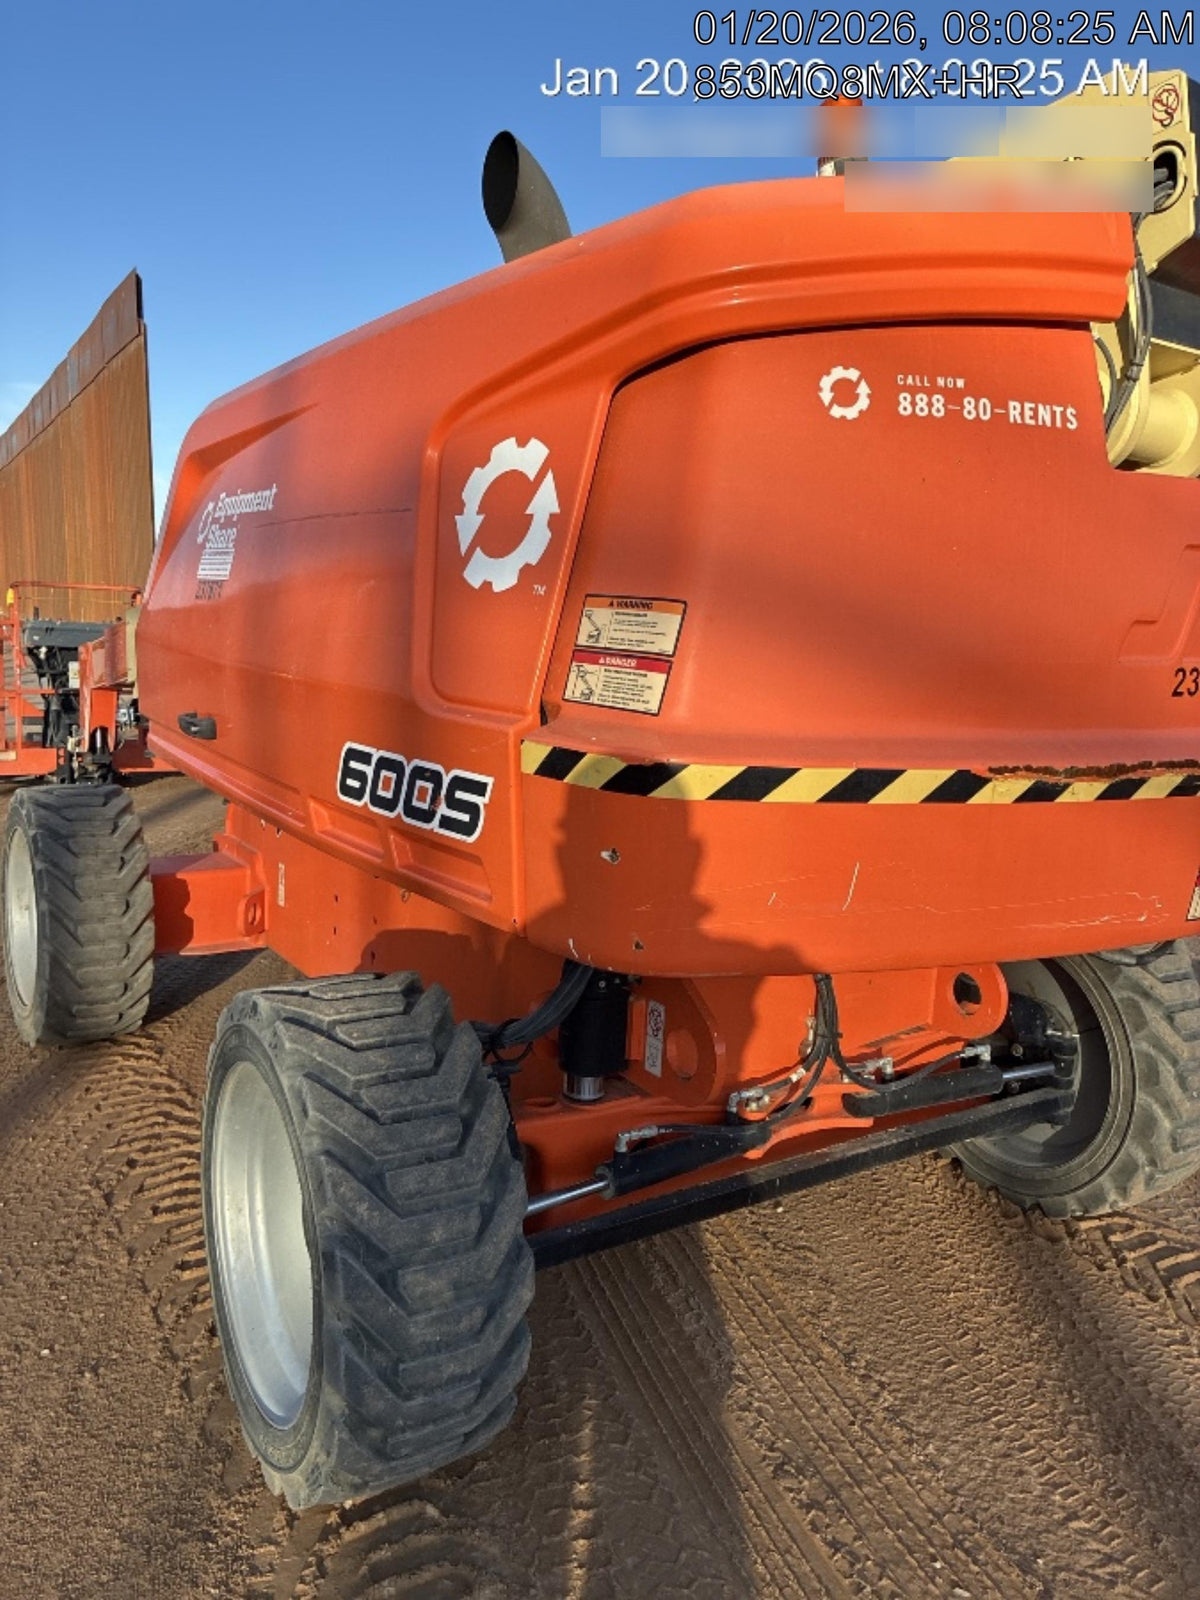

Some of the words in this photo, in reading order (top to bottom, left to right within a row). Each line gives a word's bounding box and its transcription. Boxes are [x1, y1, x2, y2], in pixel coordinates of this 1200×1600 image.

[897, 374, 930, 387] CALL
[936, 376, 966, 389] NOW
[1171, 667, 1200, 697] 23
[337, 741, 494, 843] 600S
